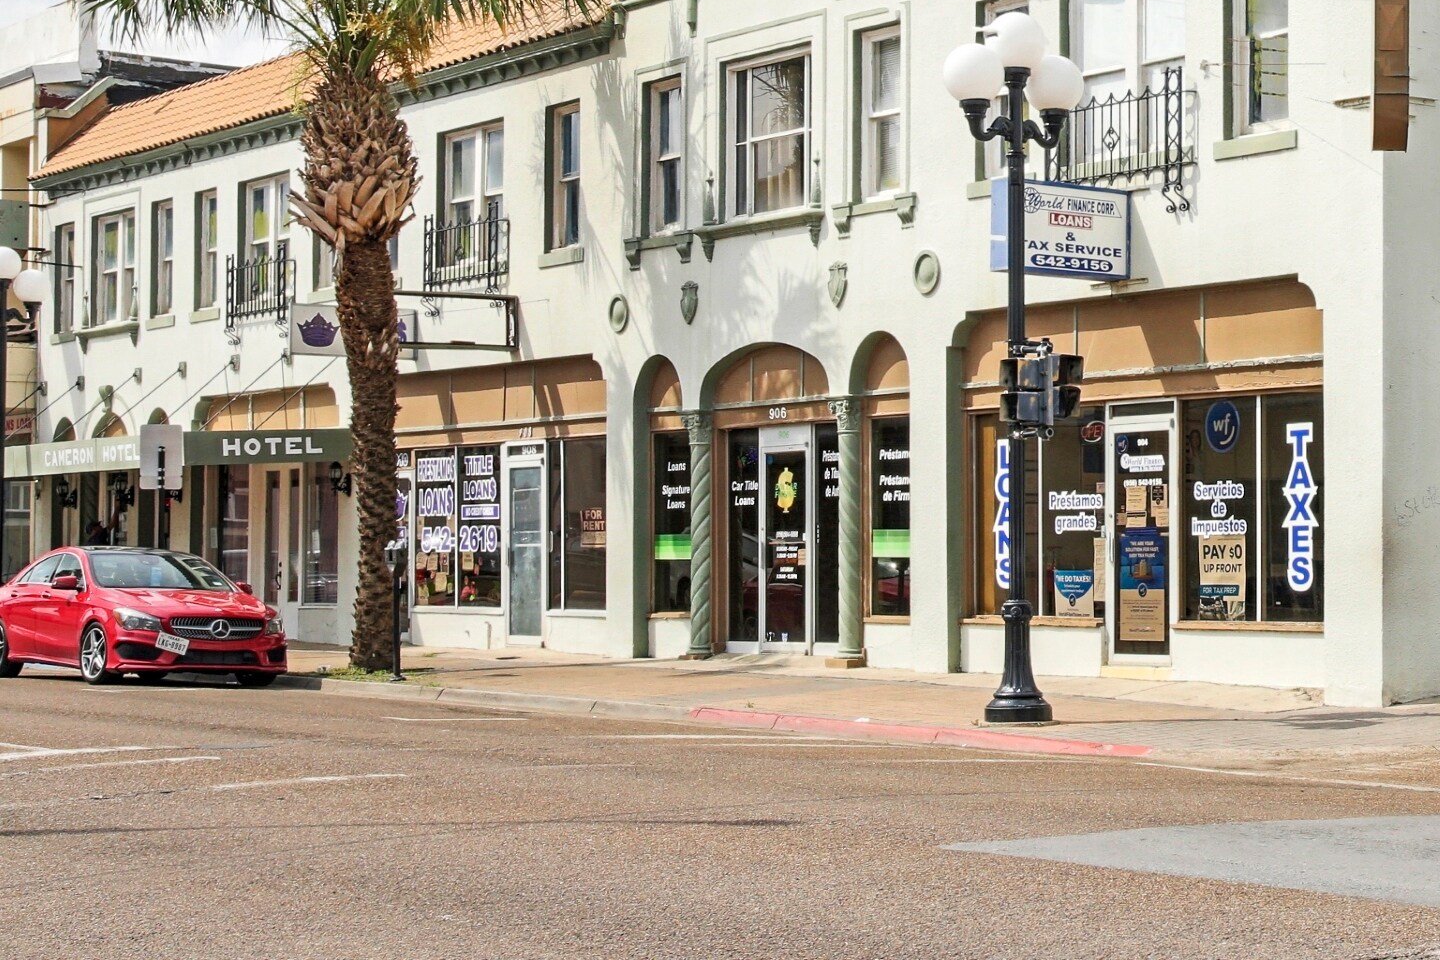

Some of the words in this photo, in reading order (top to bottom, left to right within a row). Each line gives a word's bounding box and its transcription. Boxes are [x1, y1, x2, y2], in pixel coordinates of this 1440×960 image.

[1028, 192, 1065, 210] World
[1067, 198, 1095, 213] FINANCE
[1096, 201, 1115, 216] CORP.
[1050, 213, 1092, 228] LOANS
[1065, 231, 1076, 241] &
[1055, 242, 1122, 258] SERVICE
[1035, 255, 1110, 272] 542-9156
[769, 407, 787, 420] 906
[222, 437, 323, 457] HOTEL
[522, 445, 537, 455] 908
[879, 449, 910, 460] Préstam
[44, 447, 94, 467] CAMERON
[102, 443, 140, 463] HOTEL
[464, 455, 494, 476] TITLE
[667, 461, 687, 471] Loans
[731, 480, 743, 492] Car
[744, 480, 759, 491] Title
[879, 474, 910, 486] Préstam
[463, 477, 497, 502] LOAN$
[661, 484, 691, 498] Signature
[882, 490, 893, 501] de
[893, 490, 910, 501] Firm
[1195, 482, 1244, 498] Servicios
[418, 485, 454, 520] LOAN$
[667, 499, 686, 510] Loans
[734, 496, 755, 506] Loans
[1050, 491, 1102, 509] Préstamos
[1211, 500, 1226, 515] de
[1287, 427, 1314, 587] TAXES
[585, 510, 602, 520] FOR
[583, 520, 605, 531] RENT
[1056, 514, 1096, 532] grandes
[1193, 517, 1246, 537] impuestos
[1202, 544, 1227, 560] PAY
[1228, 543, 1243, 560] $0
[1203, 563, 1215, 573] UP
[1215, 563, 1243, 573] FRONT
[1202, 586, 1213, 594] FOR
[1213, 586, 1224, 594] TAX
[1224, 586, 1237, 594] PREP
